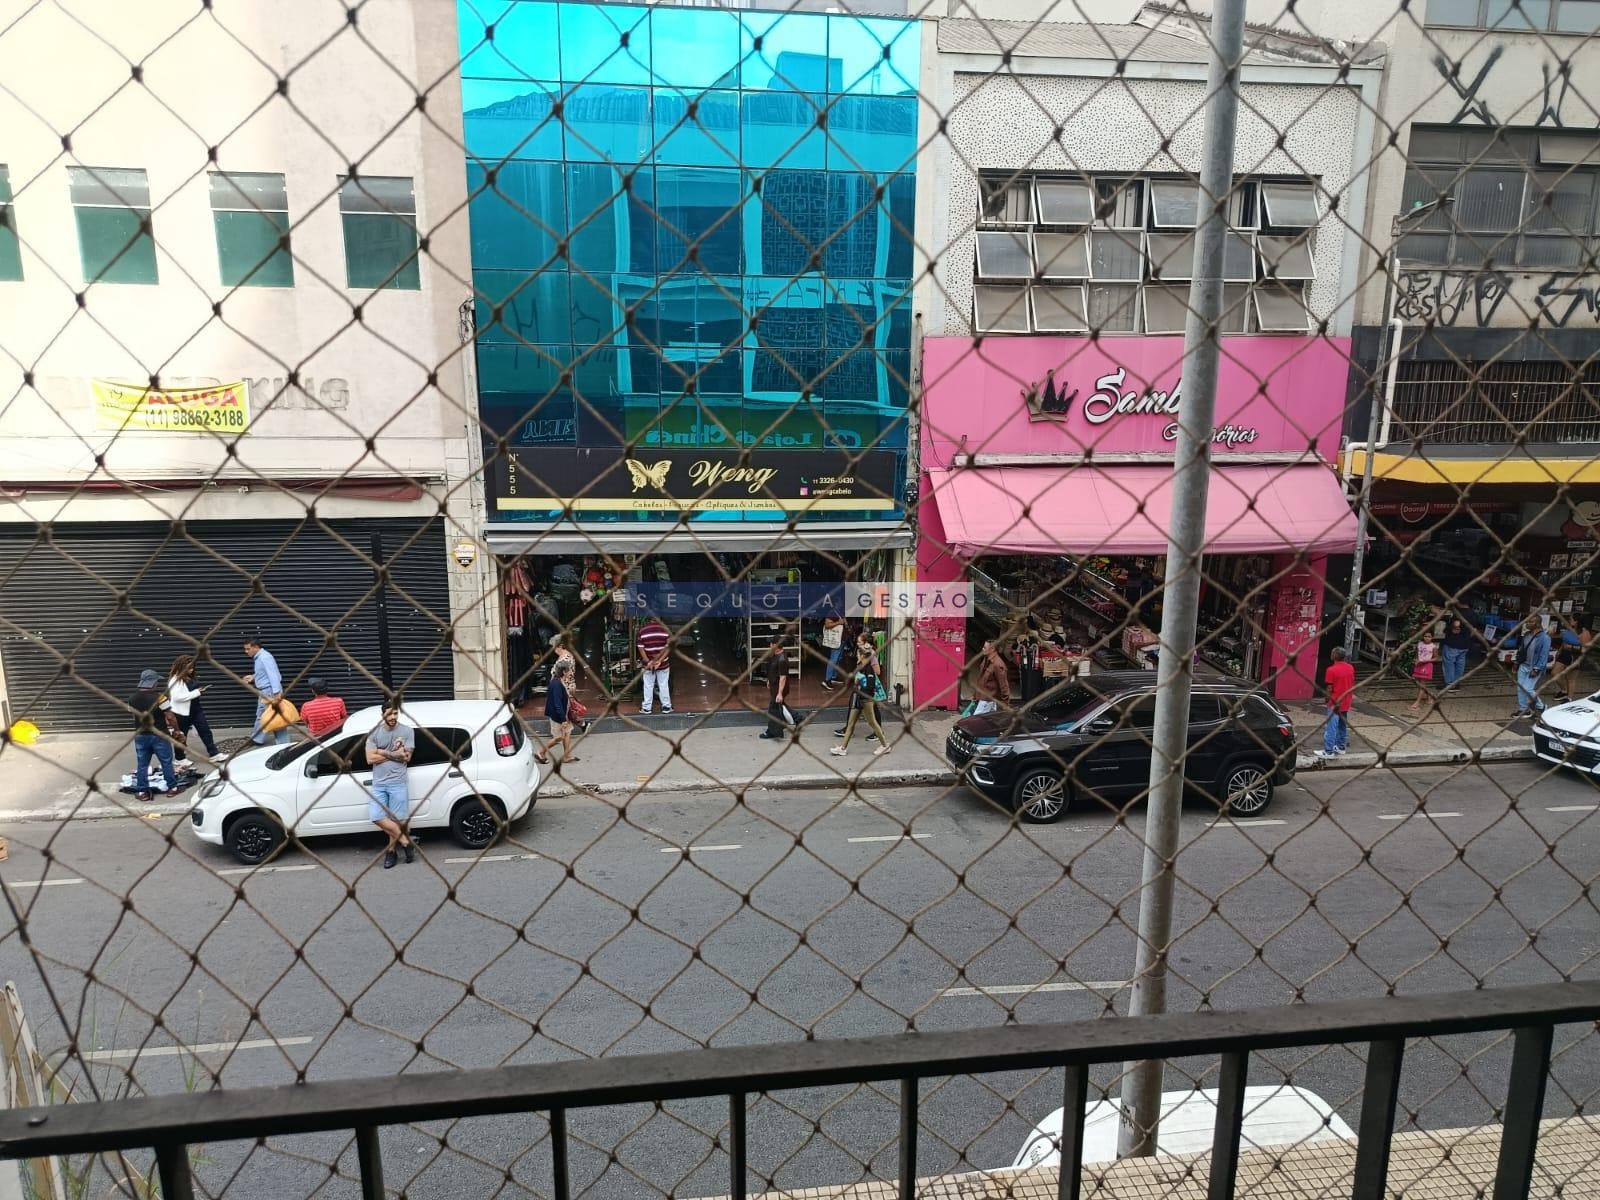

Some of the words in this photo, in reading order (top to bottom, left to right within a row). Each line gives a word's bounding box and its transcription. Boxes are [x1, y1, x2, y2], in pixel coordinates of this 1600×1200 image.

[1083, 367, 1184, 424] Samb
[145, 410, 169, 428] (11)
[173, 410, 244, 427] 98862-3188
[688, 460, 778, 493] Weng
